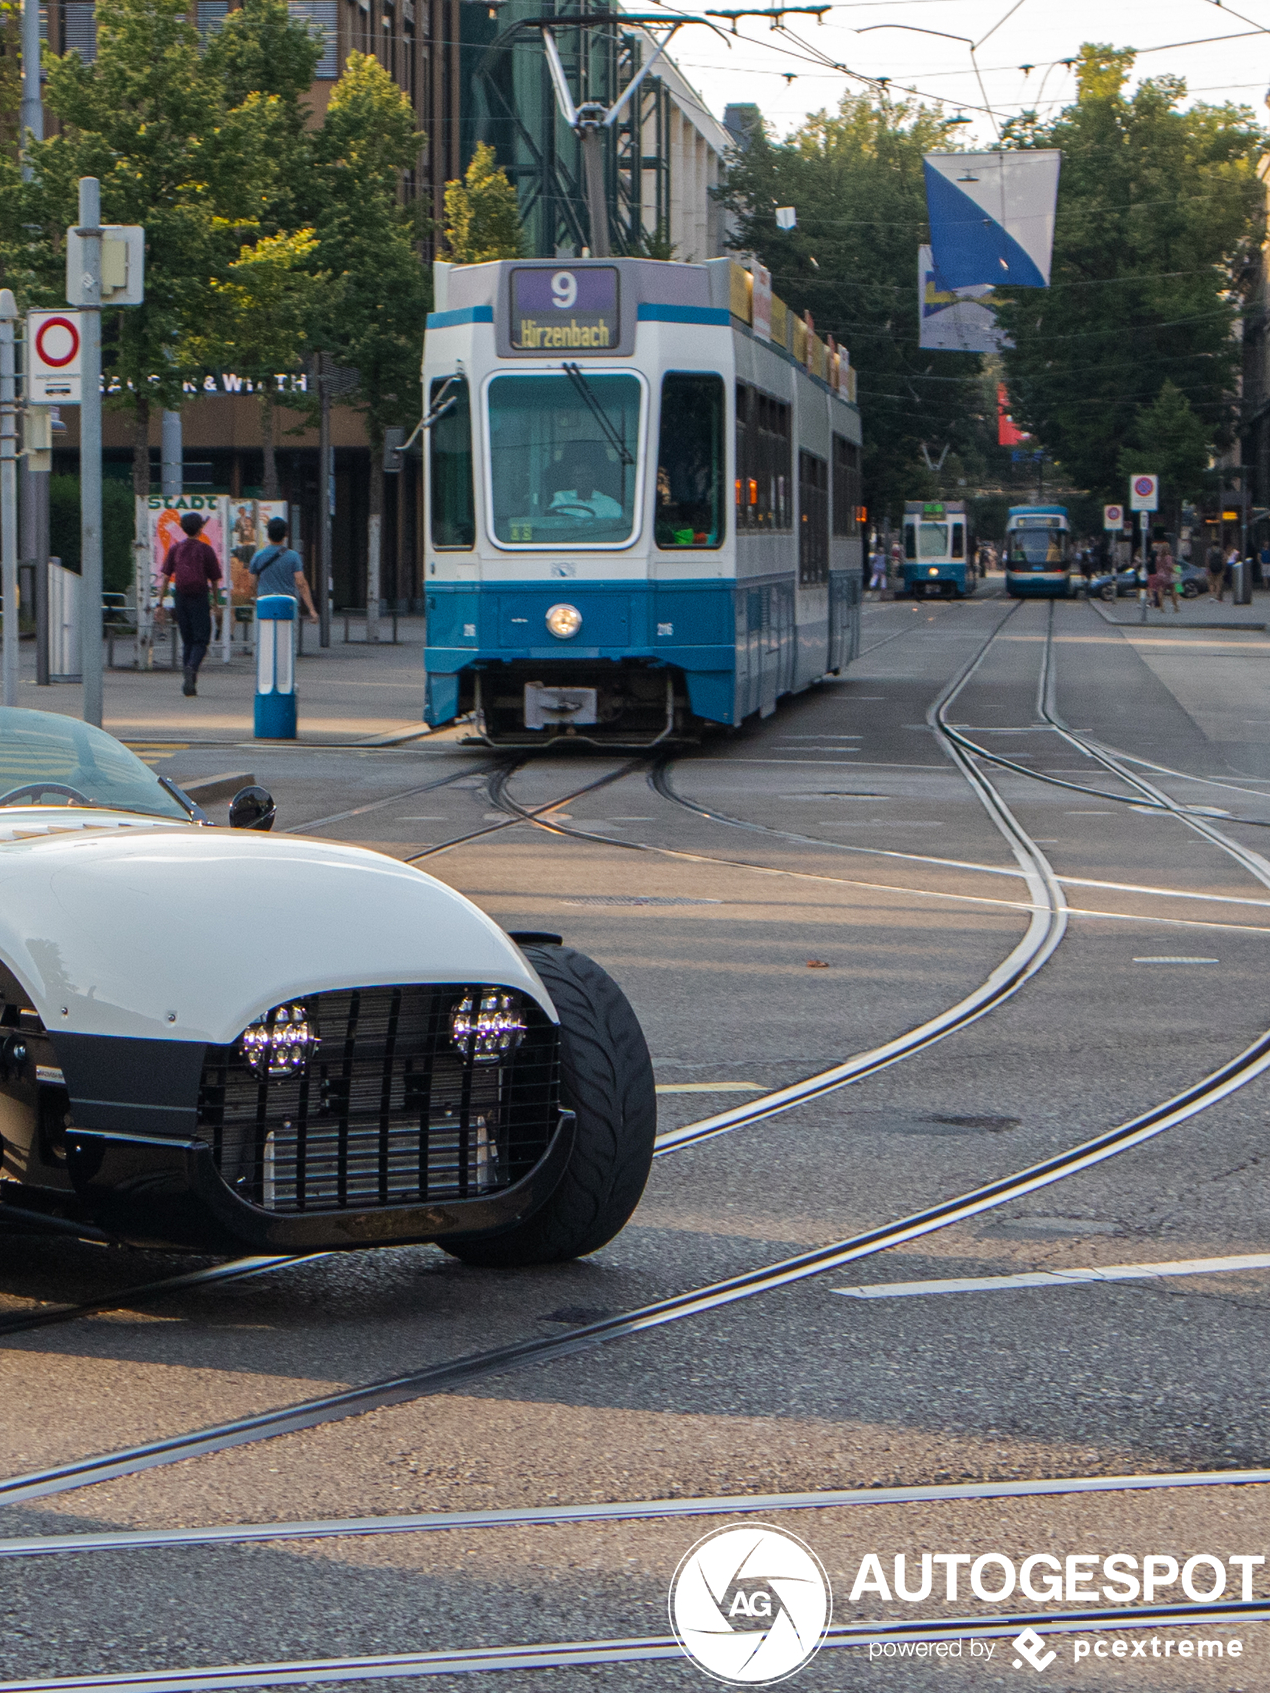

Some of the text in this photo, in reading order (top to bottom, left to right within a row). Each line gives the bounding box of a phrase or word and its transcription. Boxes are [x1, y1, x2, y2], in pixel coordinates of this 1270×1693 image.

[551, 271, 577, 309] 9
[521, 319, 609, 348] Hirzenbach
[222, 373, 308, 393] WITH
[148, 495, 218, 510] STADT
